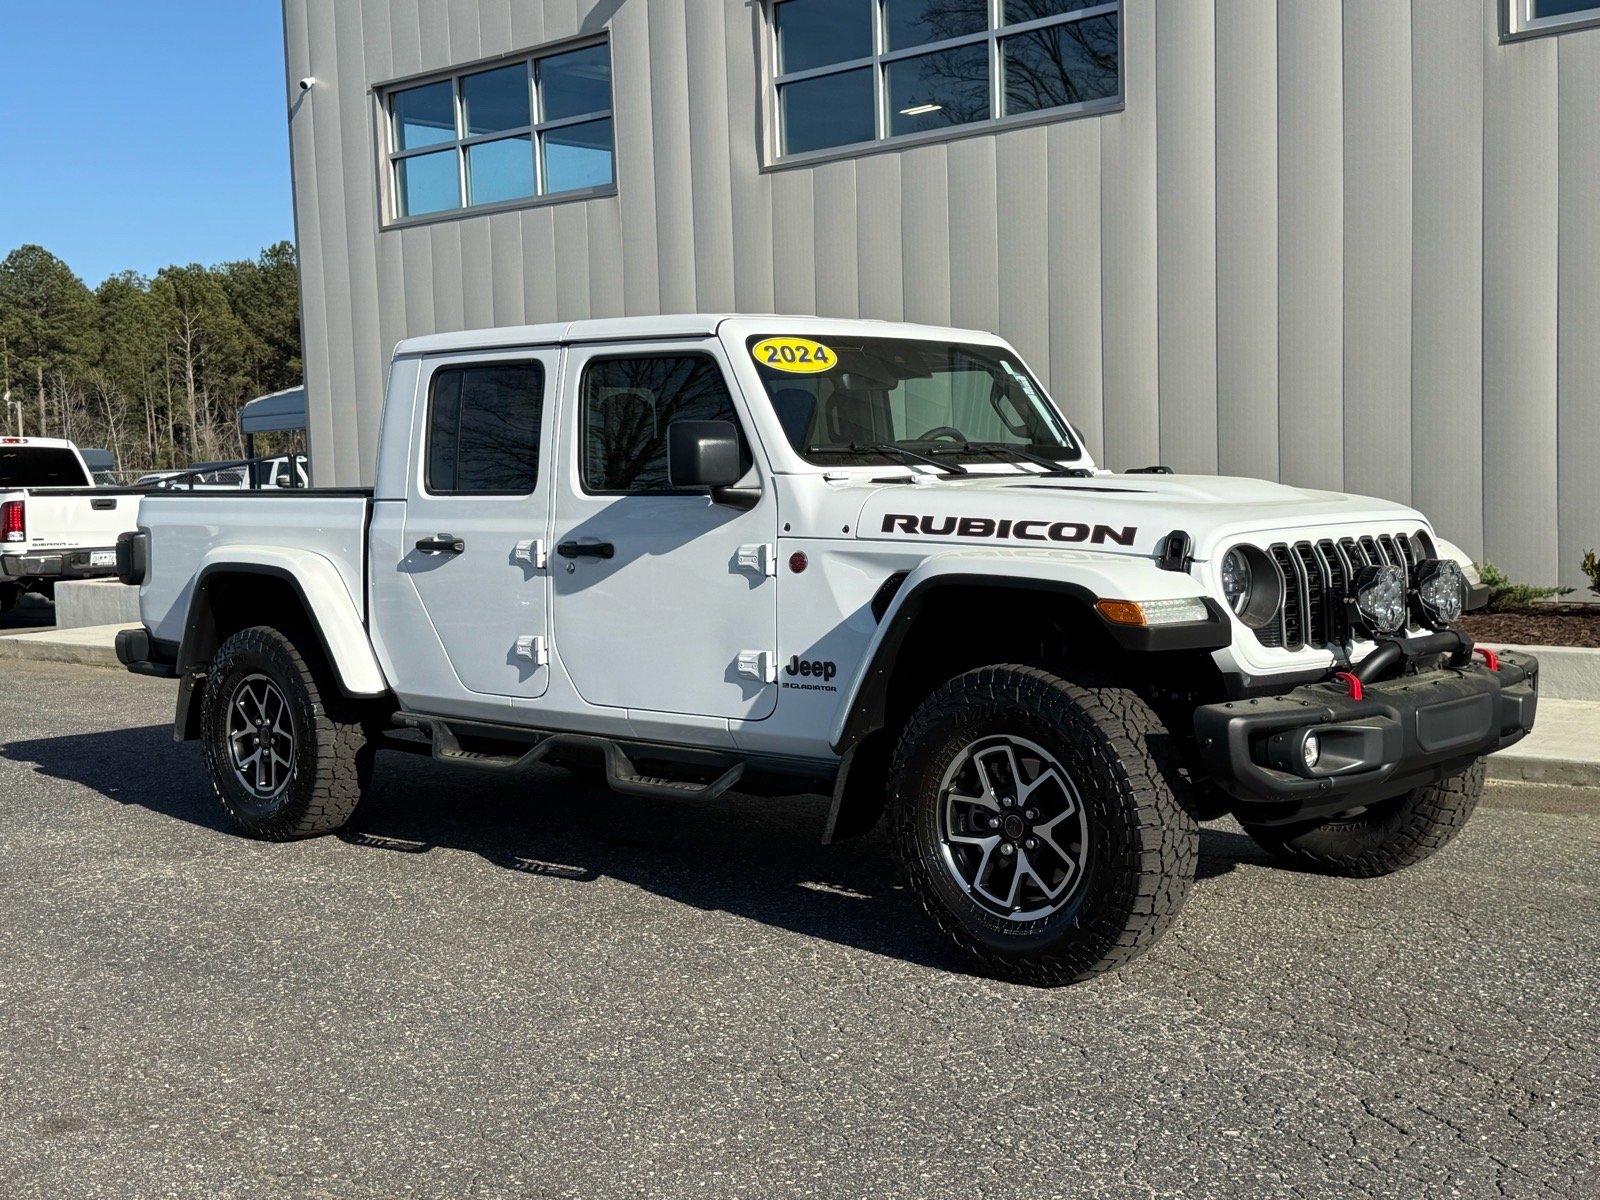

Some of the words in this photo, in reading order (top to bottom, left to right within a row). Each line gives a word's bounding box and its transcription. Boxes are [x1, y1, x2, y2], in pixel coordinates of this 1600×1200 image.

[764, 345, 828, 363] 2024
[881, 513, 1138, 546] RUBICON
[786, 655, 837, 682] Jeep
[790, 683, 837, 692] GLADIATOR
